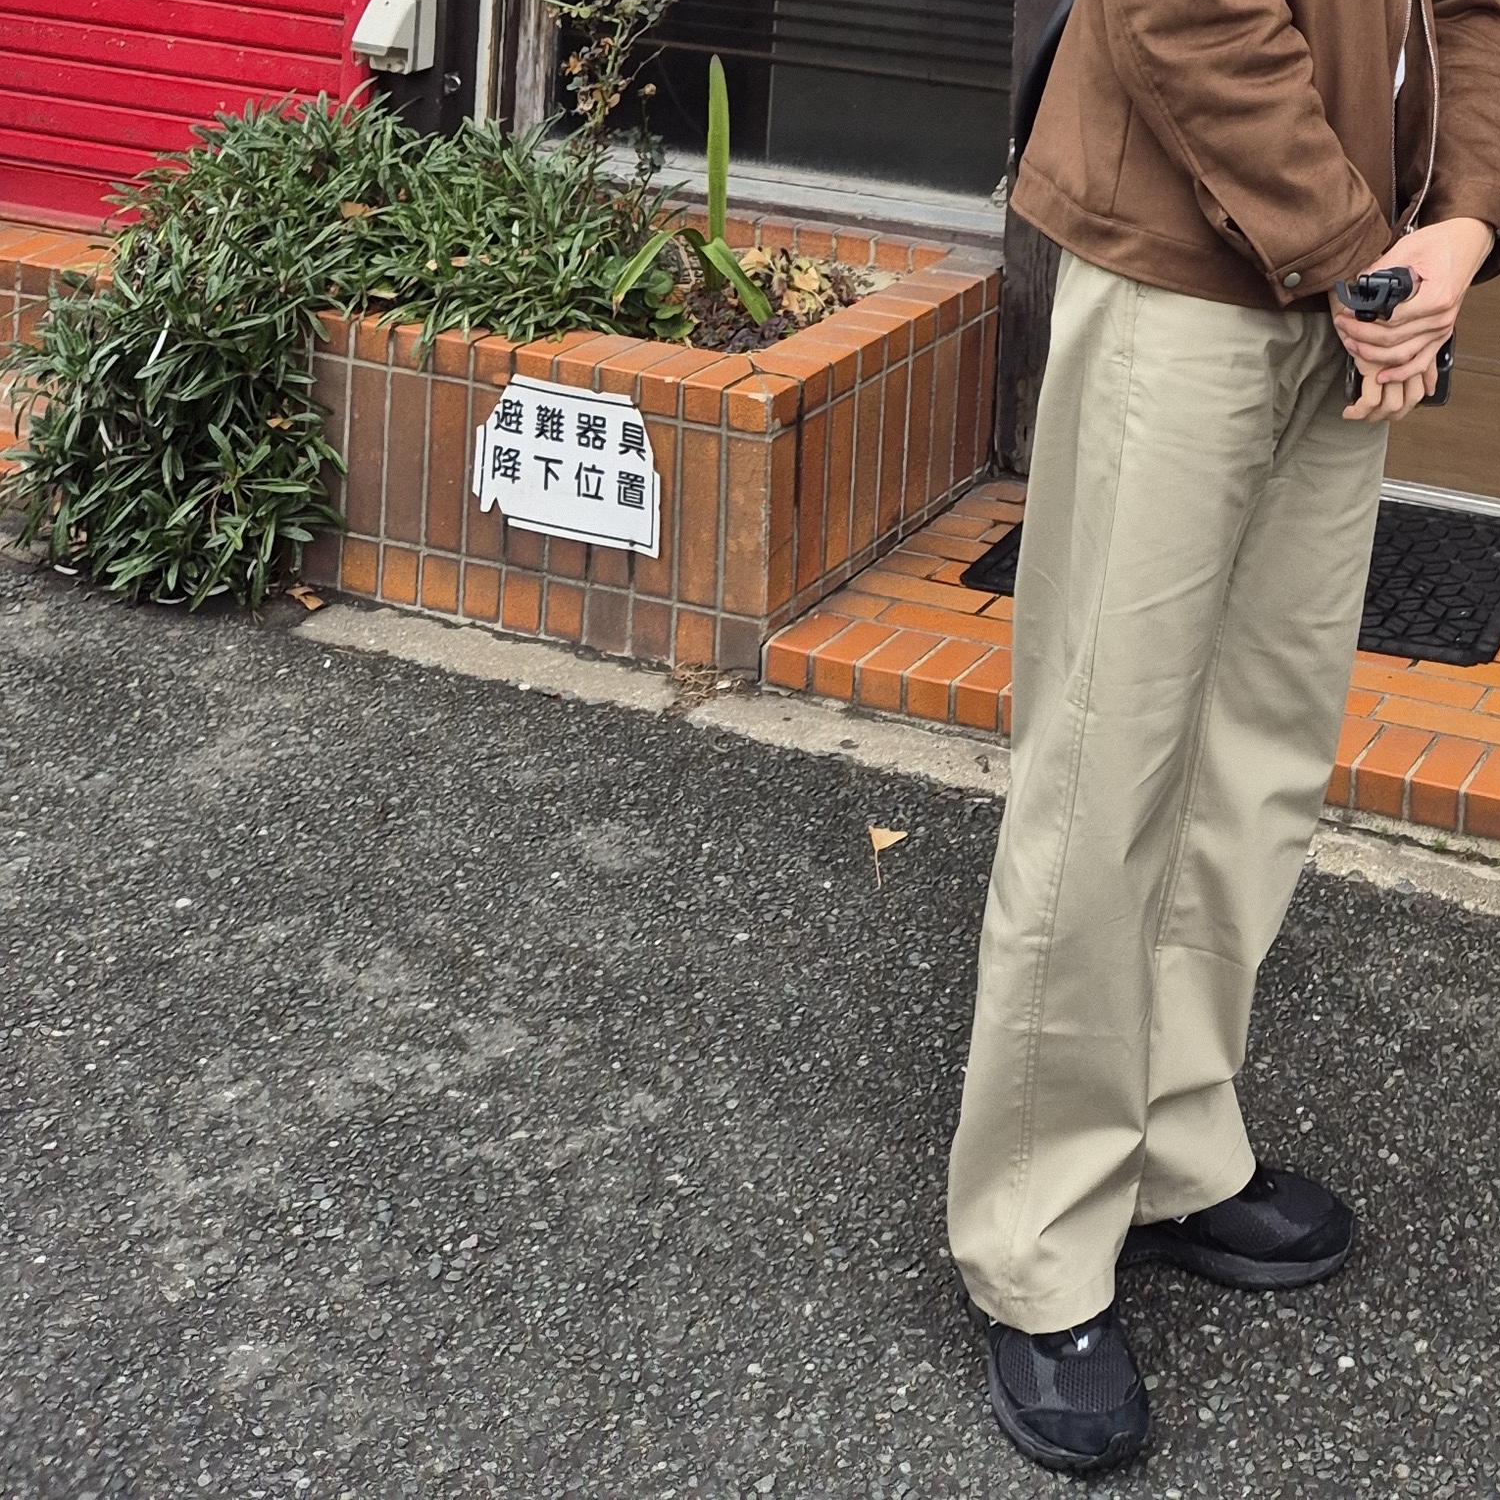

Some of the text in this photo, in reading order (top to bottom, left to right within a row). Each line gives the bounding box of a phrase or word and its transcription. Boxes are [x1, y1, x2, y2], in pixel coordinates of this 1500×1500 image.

[493, 398, 647, 462] 避難器具
[491, 445, 647, 511] 降下位置
